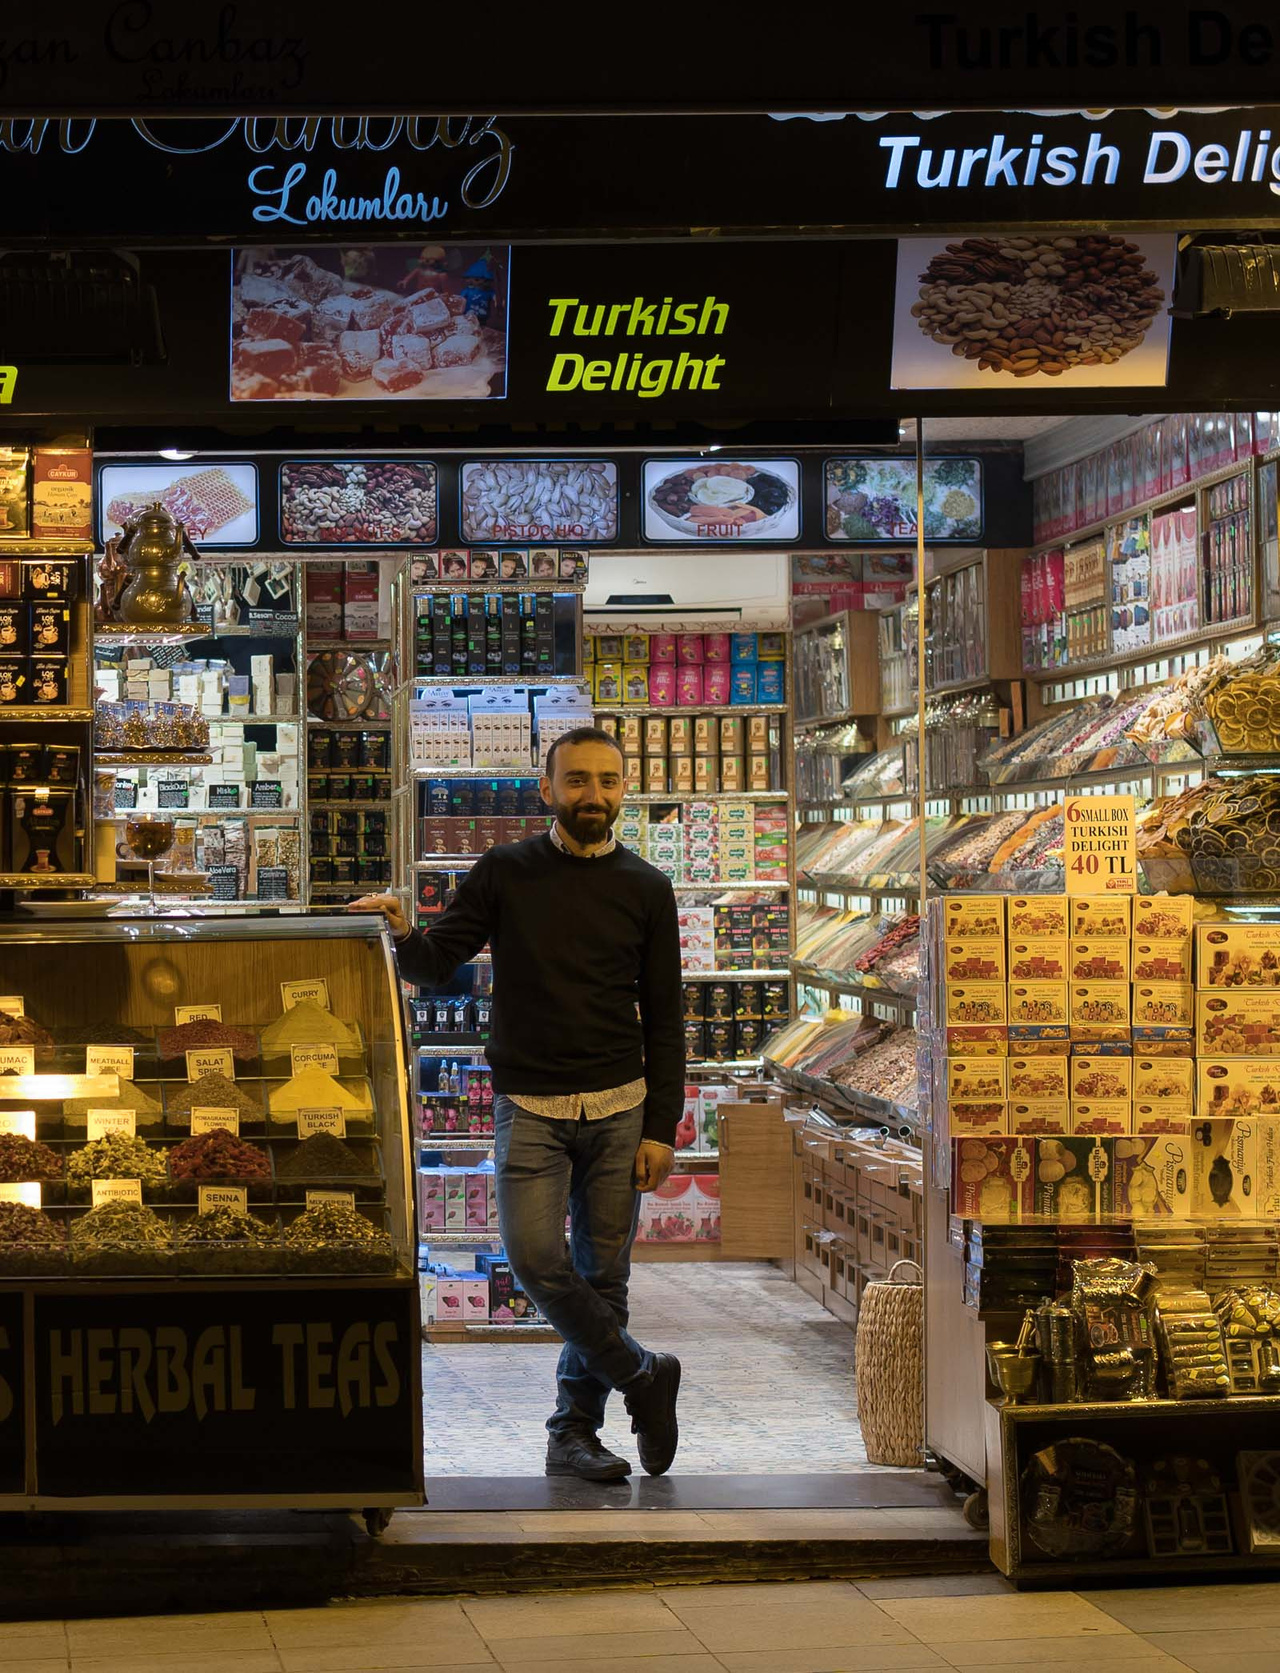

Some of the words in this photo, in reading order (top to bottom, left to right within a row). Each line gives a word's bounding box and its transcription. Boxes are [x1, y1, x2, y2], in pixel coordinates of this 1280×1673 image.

[913, 11, 1162, 69] Turkish
[878, 131, 1122, 190] Turkish
[1142, 128, 1280, 196] Deli
[247, 163, 449, 226] Lokumları
[547, 296, 730, 337] Turkish
[546, 353, 726, 398] Delight
[493, 524, 551, 538] PISTOC
[555, 524, 584, 537] HIO
[697, 523, 743, 537] FRUIT
[890, 522, 918, 535] TEA
[255, 783, 276, 791] Amber
[1066, 800, 1081, 822] 6
[1081, 808, 1110, 822] SMALL
[1111, 808, 1129, 821] BOX
[1071, 826, 1128, 837] TURKISH
[1072, 840, 1129, 852] DELIGHT
[1071, 854, 1099, 875] 40
[1105, 856, 1133, 874] TL
[291, 989, 318, 999] CURRY
[189, 1013, 207, 1022] RED
[90, 1058, 130, 1066] MEATBALL
[196, 1058, 225, 1067] SALAT
[294, 1053, 335, 1063] CORCUMA
[93, 1117, 130, 1126] WINTER
[303, 1113, 339, 1121] TURKISH
[307, 1120, 336, 1129] BLACK
[96, 1189, 139, 1197] ANTIBIOTIC
[205, 1193, 240, 1203] SENNA
[49, 1323, 257, 1425] HERBAL
[272, 1319, 401, 1420] TEAS
